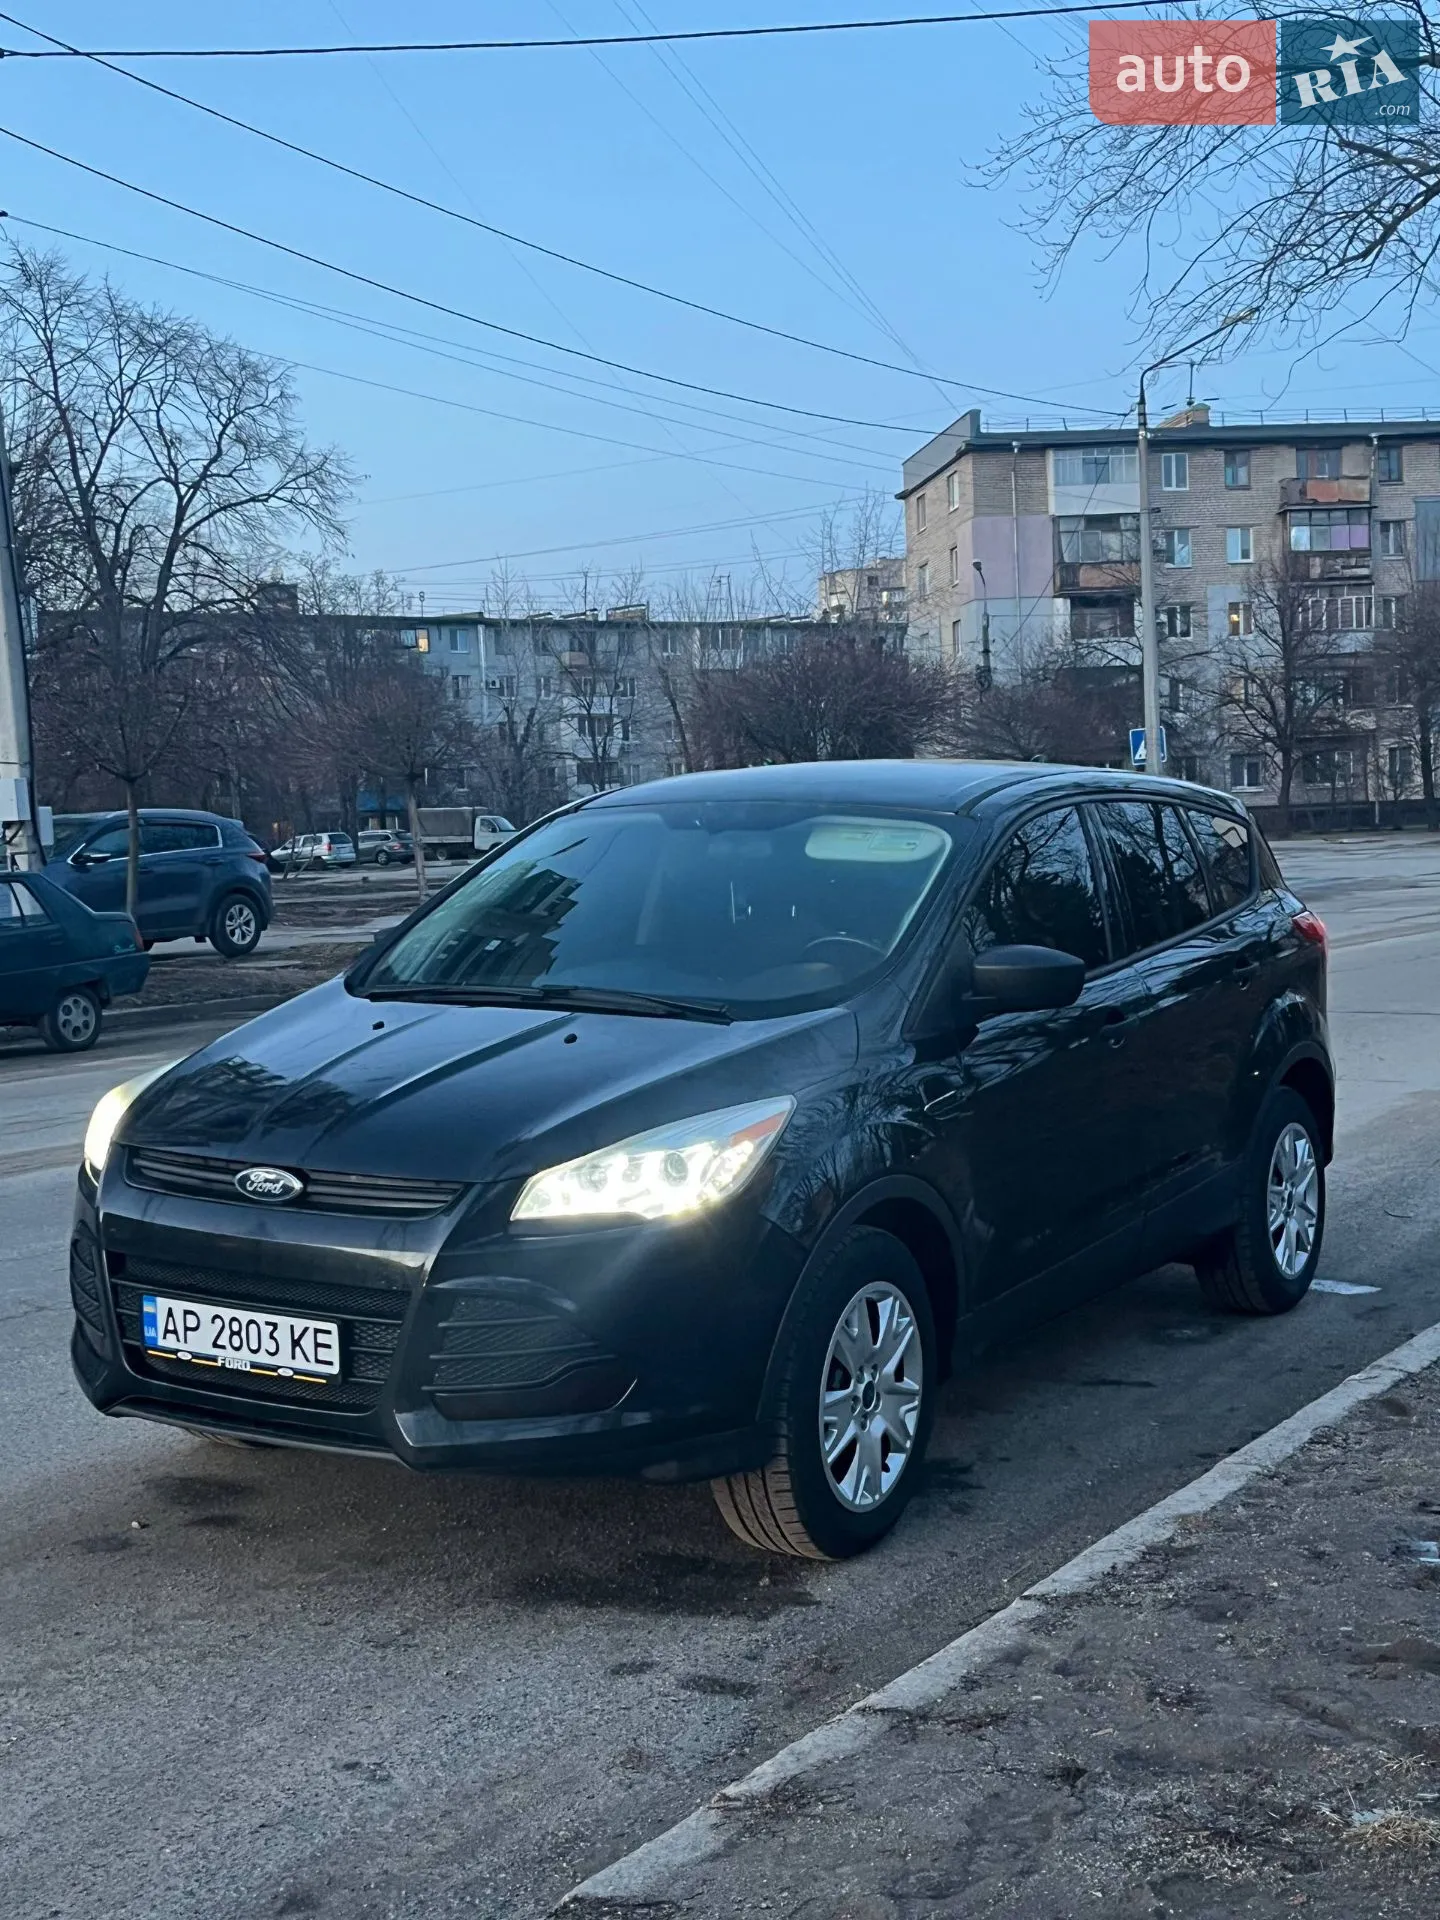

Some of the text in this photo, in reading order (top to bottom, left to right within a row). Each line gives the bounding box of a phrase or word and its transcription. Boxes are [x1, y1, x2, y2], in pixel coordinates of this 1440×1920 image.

[246, 1171, 285, 1194] Ford
[144, 1326, 157, 1337] UA
[162, 1306, 334, 1366] AP 2803 KE
[217, 1356, 251, 1371] FORD
